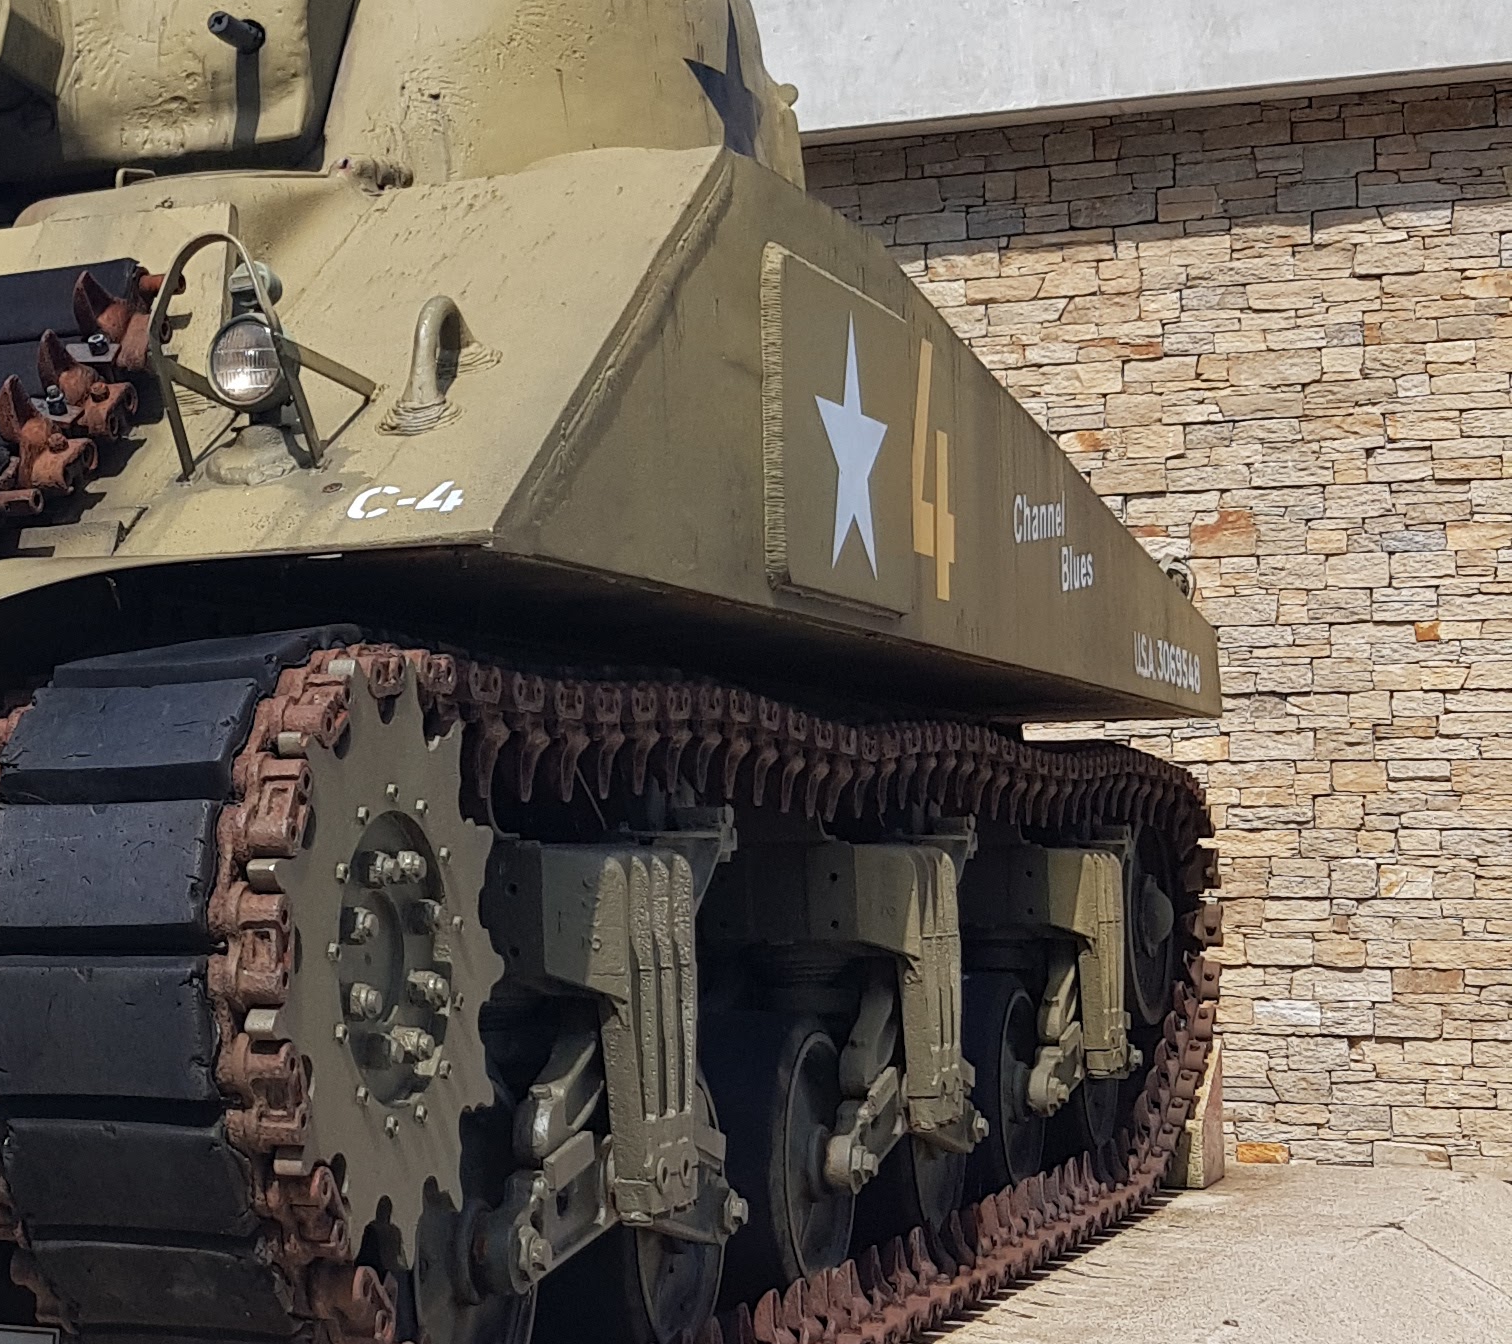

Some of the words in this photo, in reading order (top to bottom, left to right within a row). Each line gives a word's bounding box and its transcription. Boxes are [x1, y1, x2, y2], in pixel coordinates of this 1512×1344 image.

[912, 338, 955, 602] 4
[346, 480, 464, 520] C-4
[1013, 490, 1066, 544] Channel
[1061, 545, 1094, 592] Blues
[1156, 639, 1201, 694] 3069548
